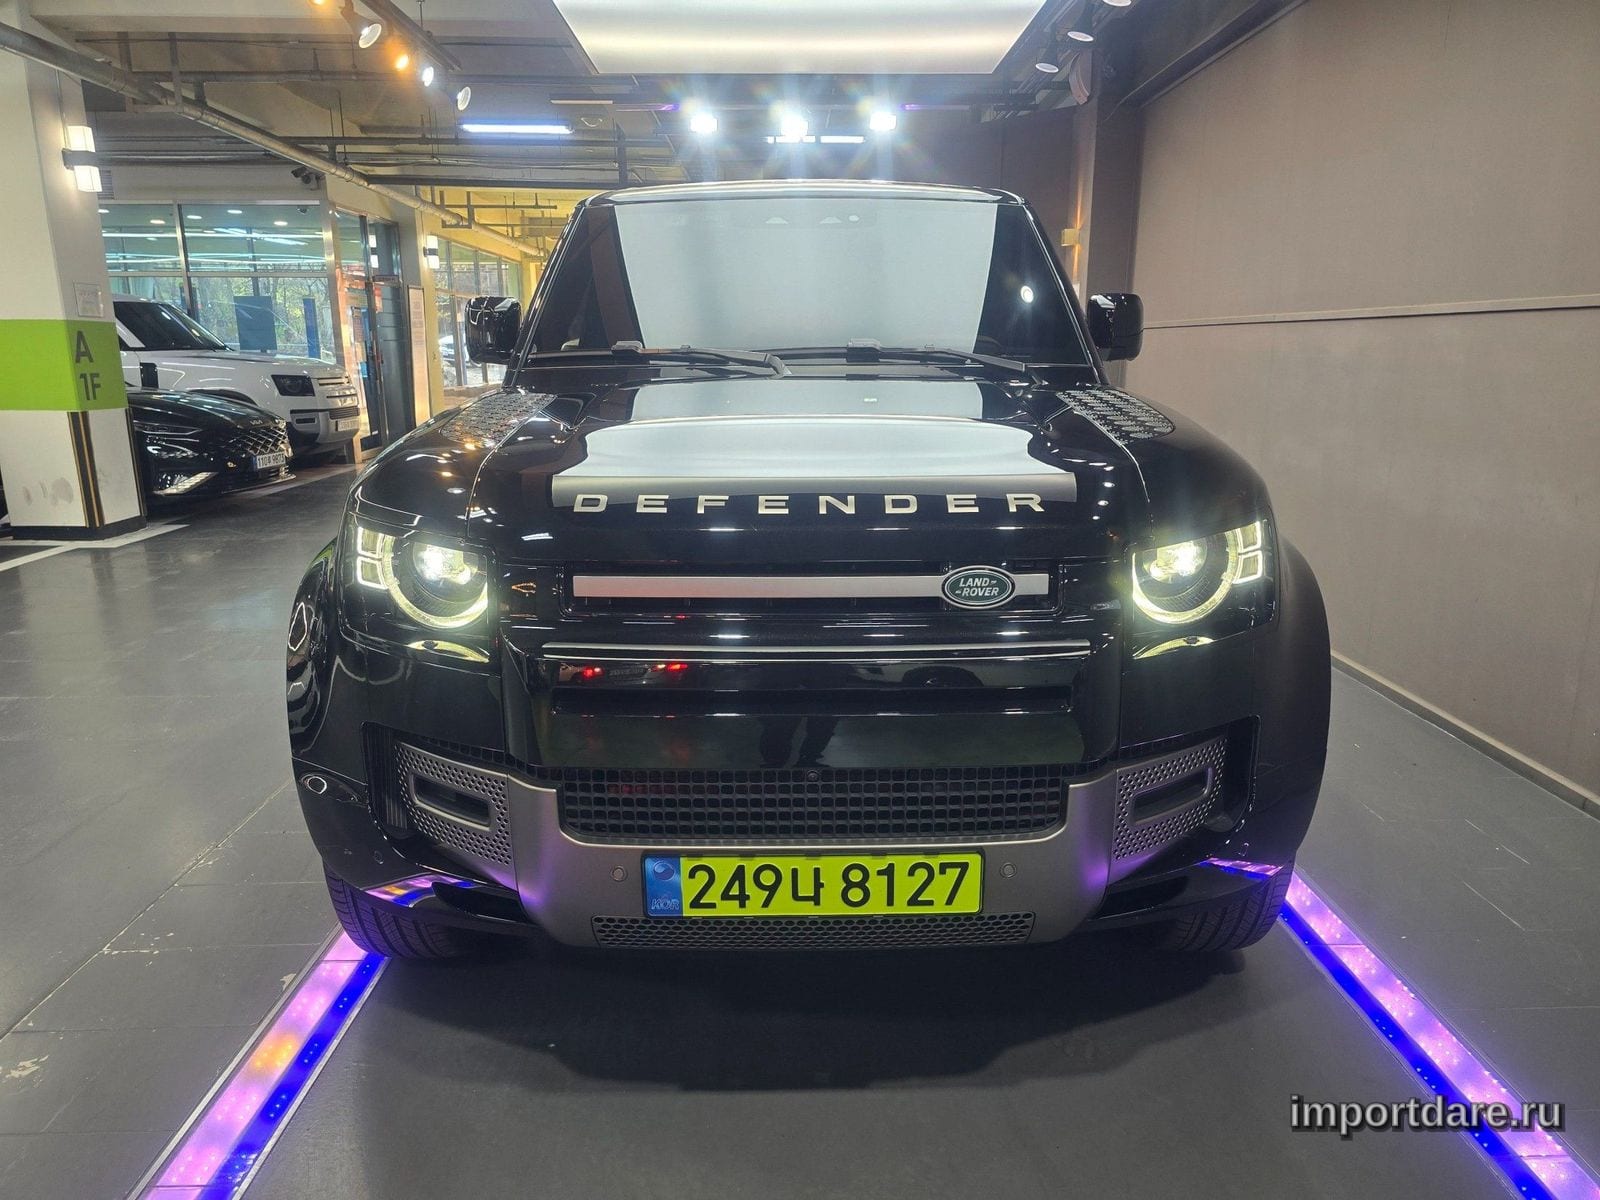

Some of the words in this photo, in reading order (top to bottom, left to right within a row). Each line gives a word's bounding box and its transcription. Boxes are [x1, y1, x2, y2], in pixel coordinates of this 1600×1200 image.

[75, 330, 94, 363] A
[80, 373, 101, 401] 1F
[573, 493, 1046, 515] DEFENDER
[959, 577, 990, 587] LAND
[962, 587, 1000, 597] ROVER
[688, 863, 825, 910] 249나
[840, 861, 970, 908] 8127
[651, 898, 681, 911] KOR
